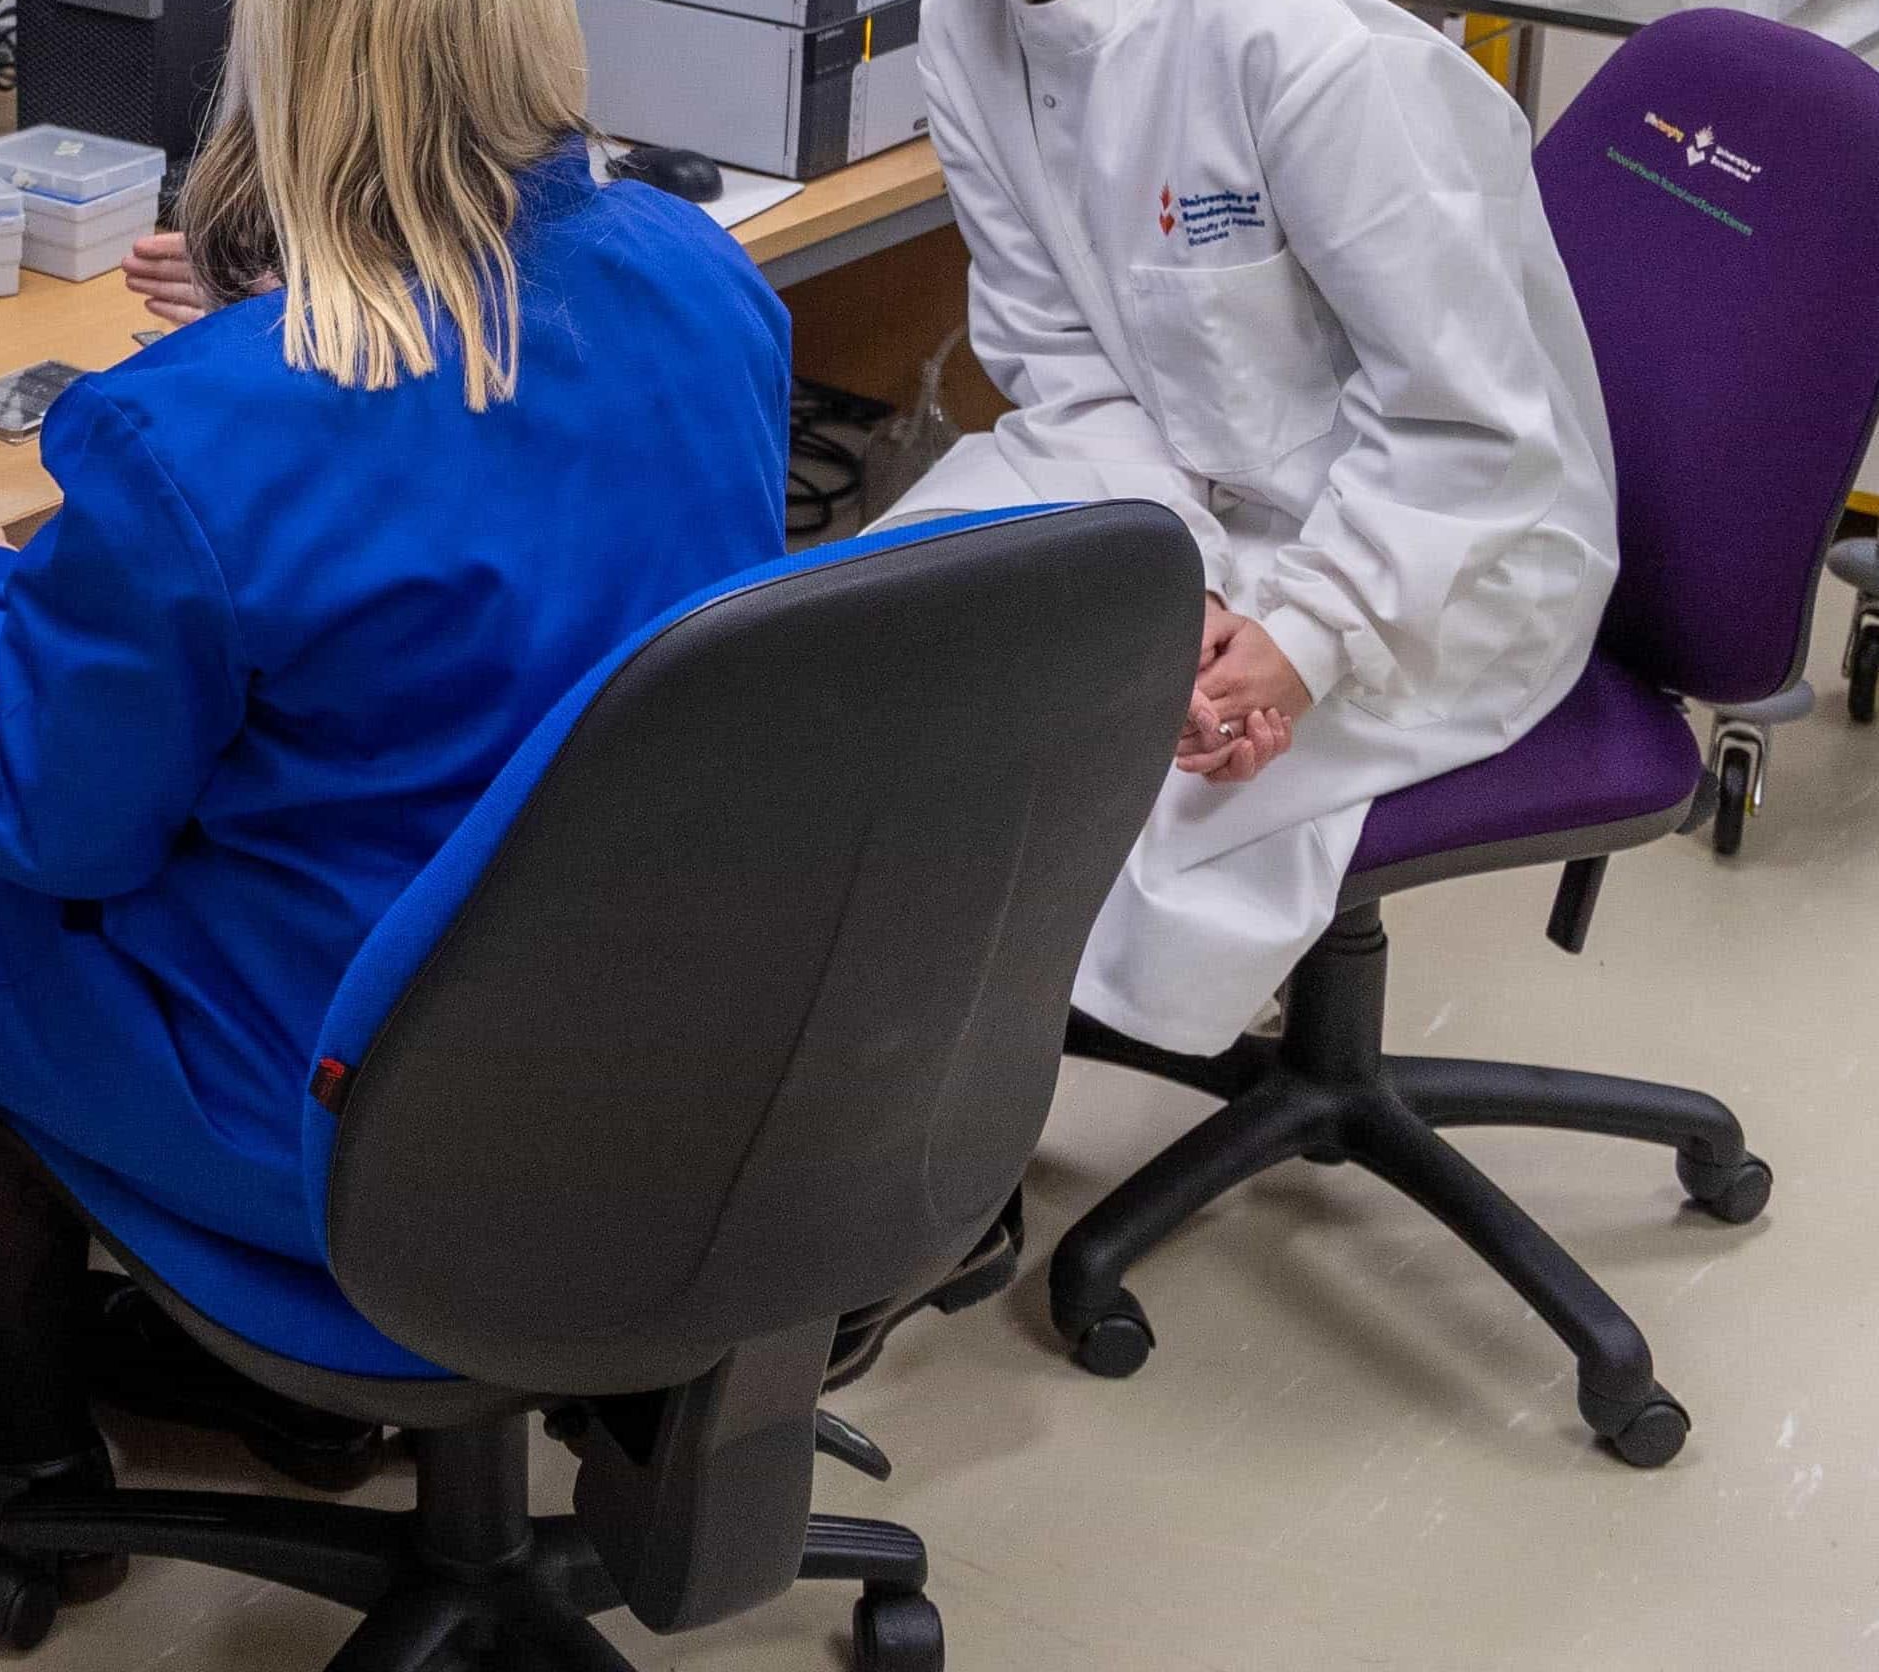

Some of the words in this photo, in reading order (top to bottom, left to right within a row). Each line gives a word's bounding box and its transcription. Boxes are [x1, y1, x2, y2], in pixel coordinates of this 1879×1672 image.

[1178, 190, 1243, 208] University
[1246, 191, 1261, 203] of
[1182, 204, 1257, 222] Sunderland
[1185, 221, 1220, 236] Faculty
[1221, 218, 1231, 228] of
[1187, 230, 1230, 248] Sciences
